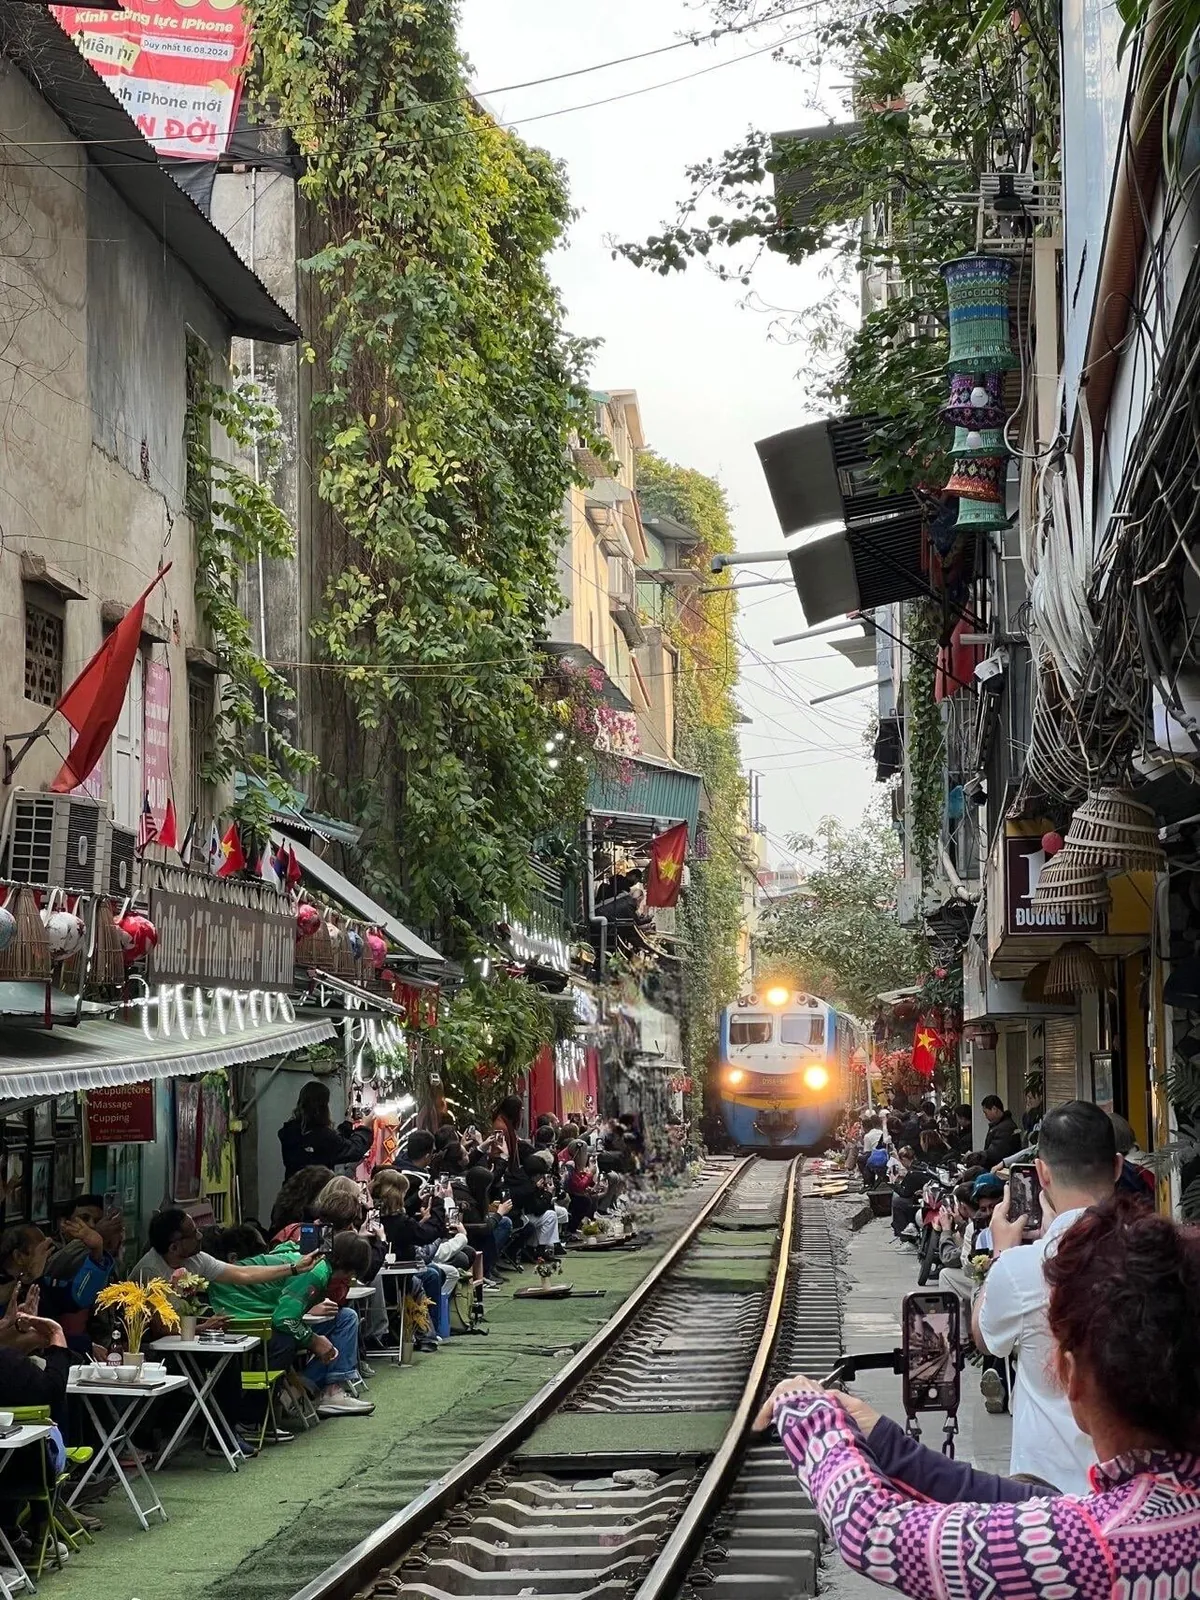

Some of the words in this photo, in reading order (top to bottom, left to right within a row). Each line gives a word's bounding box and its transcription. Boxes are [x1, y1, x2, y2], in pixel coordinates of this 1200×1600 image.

[153, 14, 178, 29] lực
[182, 45, 229, 57] 16.08.2024
[136, 90, 188, 109] iPhone
[192, 99, 222, 113] mới
[164, 116, 217, 145] ĐỜI
[203, 911, 228, 978] Train
[228, 915, 256, 982] Street
[92, 1101, 133, 1110] Massage
[92, 1113, 130, 1123] Cupping
